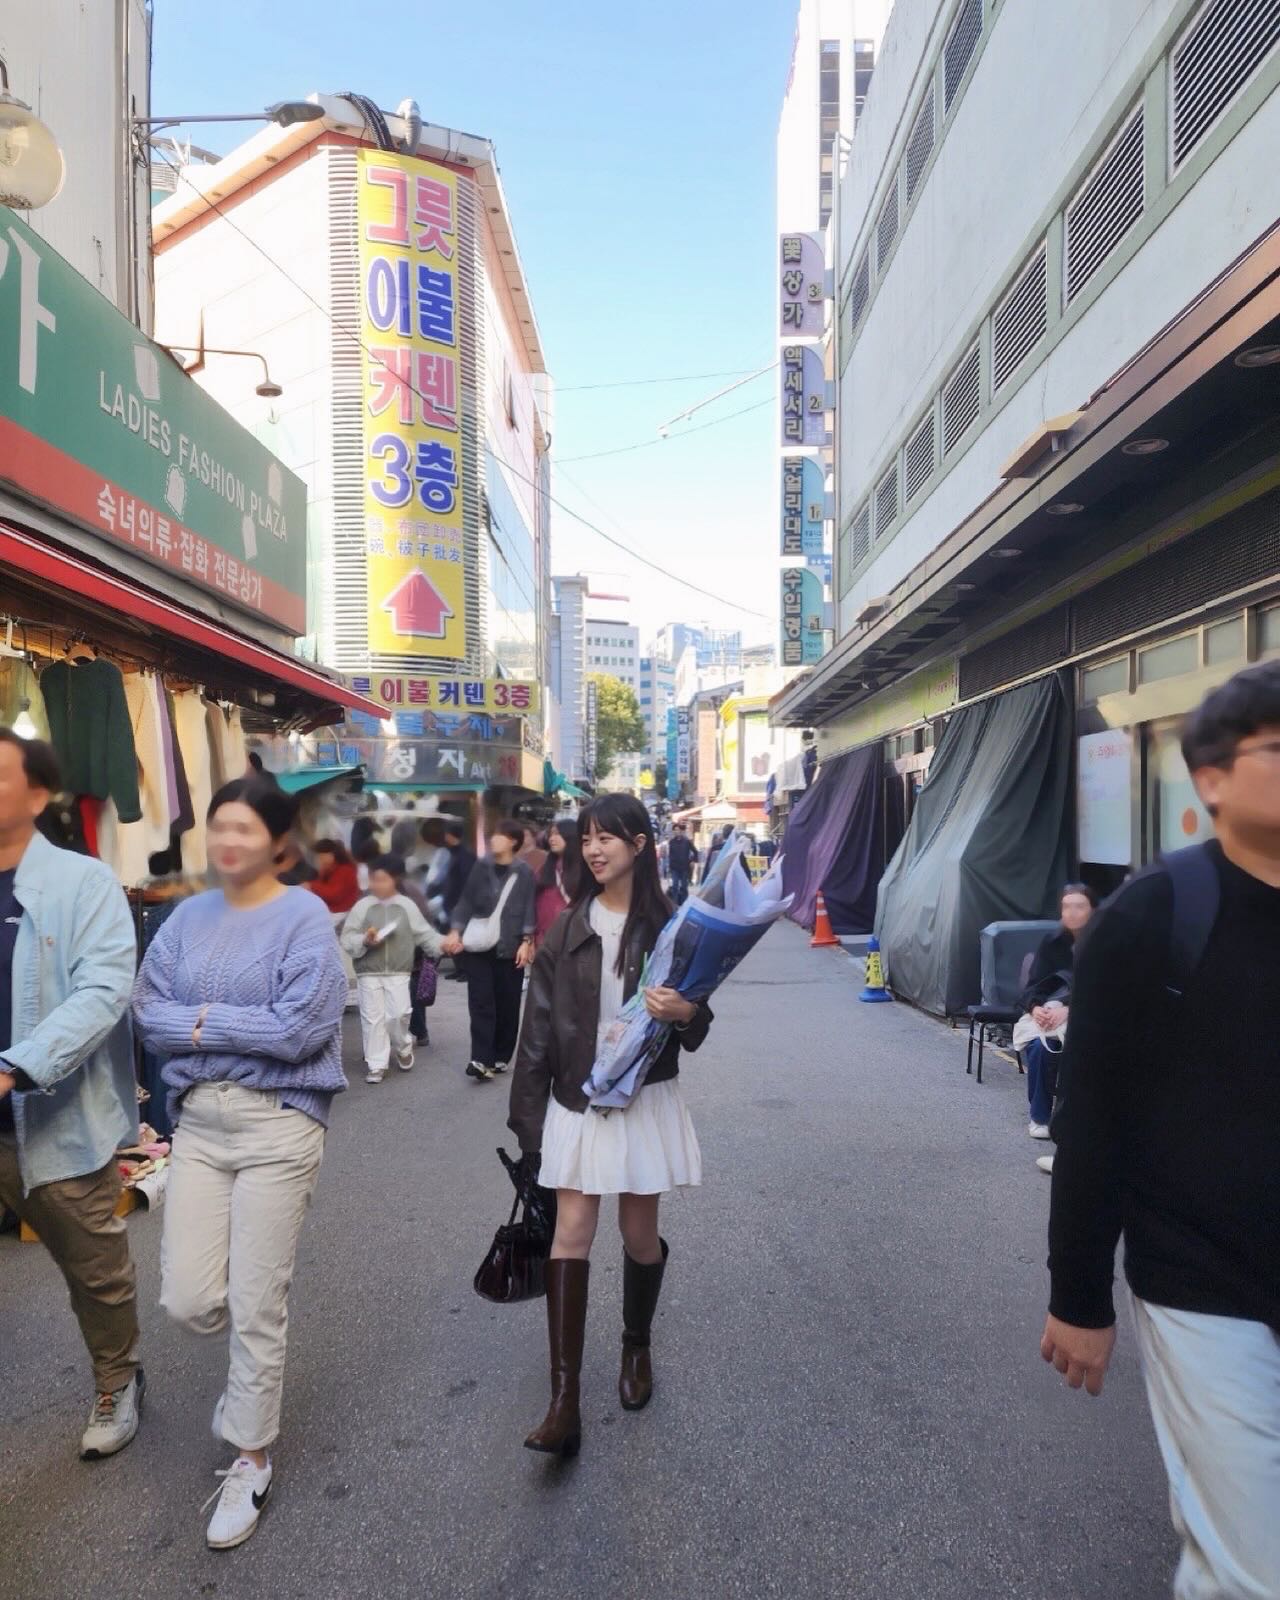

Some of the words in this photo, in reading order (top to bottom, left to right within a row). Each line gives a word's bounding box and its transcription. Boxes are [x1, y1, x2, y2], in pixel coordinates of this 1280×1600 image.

[366, 165, 455, 260] 그릇
[366, 256, 457, 347] 이불
[783, 238, 803, 328] 꽃상가
[367, 344, 458, 433] 커텐
[100, 371, 171, 456] LADIES
[179, 433, 245, 511] FASHION
[250, 490, 287, 543] PLAZA
[369, 432, 459, 514] 3층
[214, 551, 263, 609] 전문상가
[380, 678, 430, 705] 이불
[438, 681, 485, 706] 커텐
[494, 683, 531, 708] 3층
